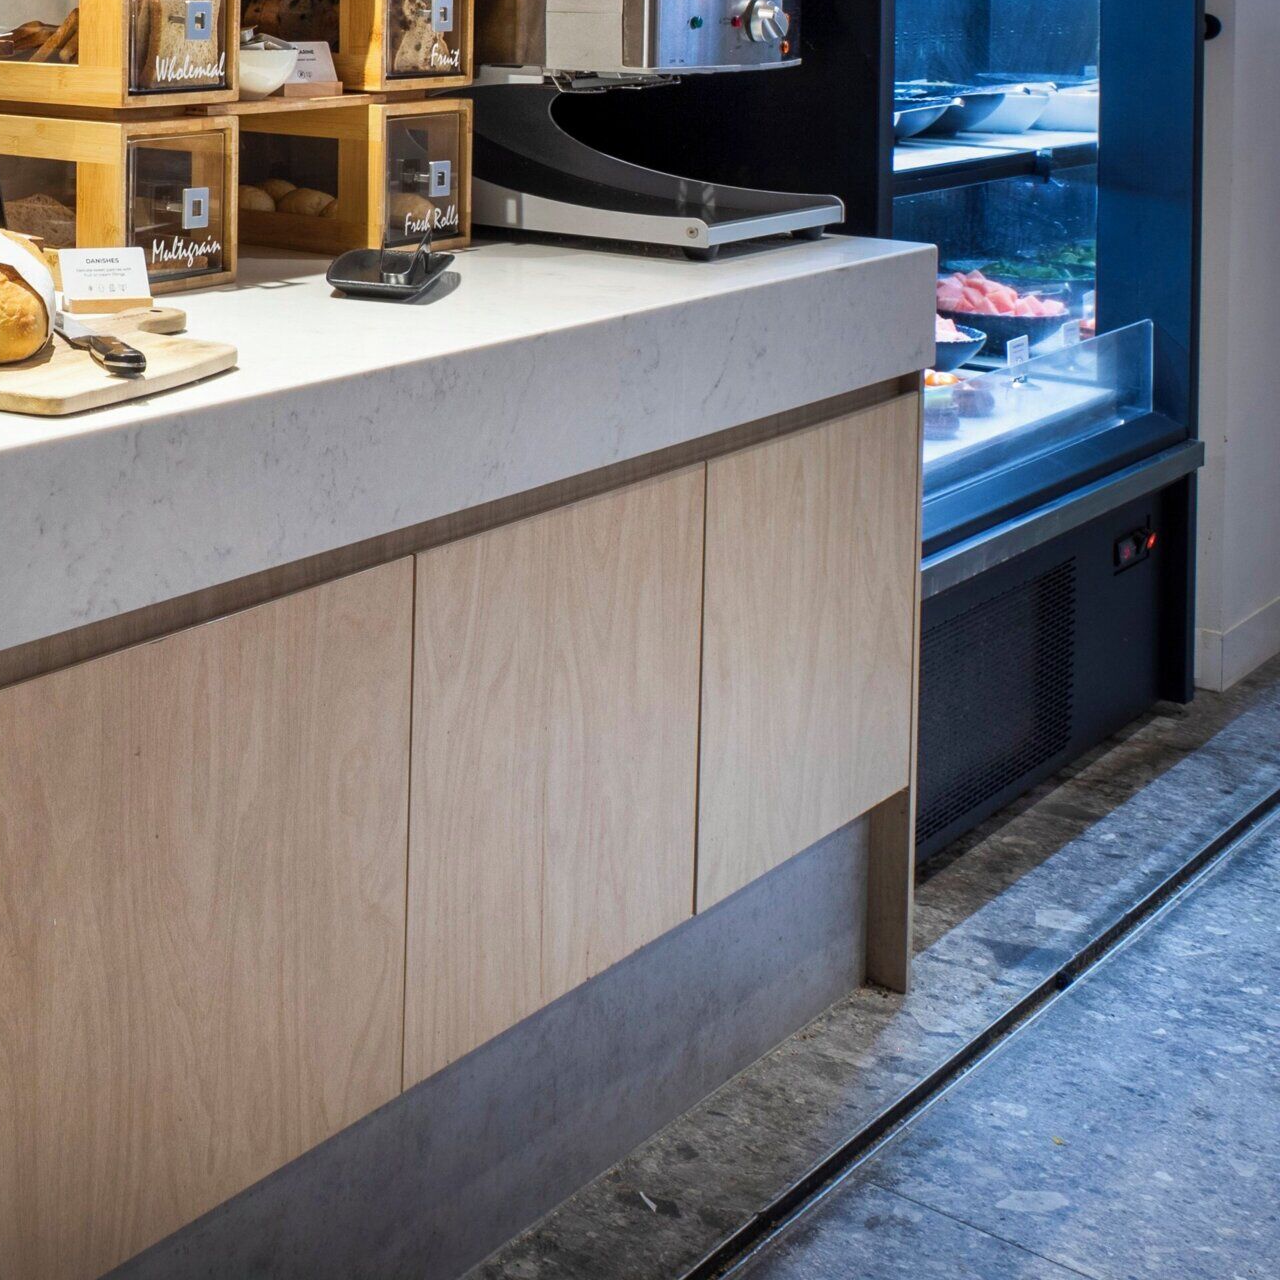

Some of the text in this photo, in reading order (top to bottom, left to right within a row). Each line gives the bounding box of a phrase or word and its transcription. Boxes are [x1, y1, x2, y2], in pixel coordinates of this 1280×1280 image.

[155, 51, 226, 82] Wholemeal
[430, 42, 460, 67] Fruit
[404, 204, 459, 236] Fresh Rolls
[151, 234, 221, 268] Multigrain
